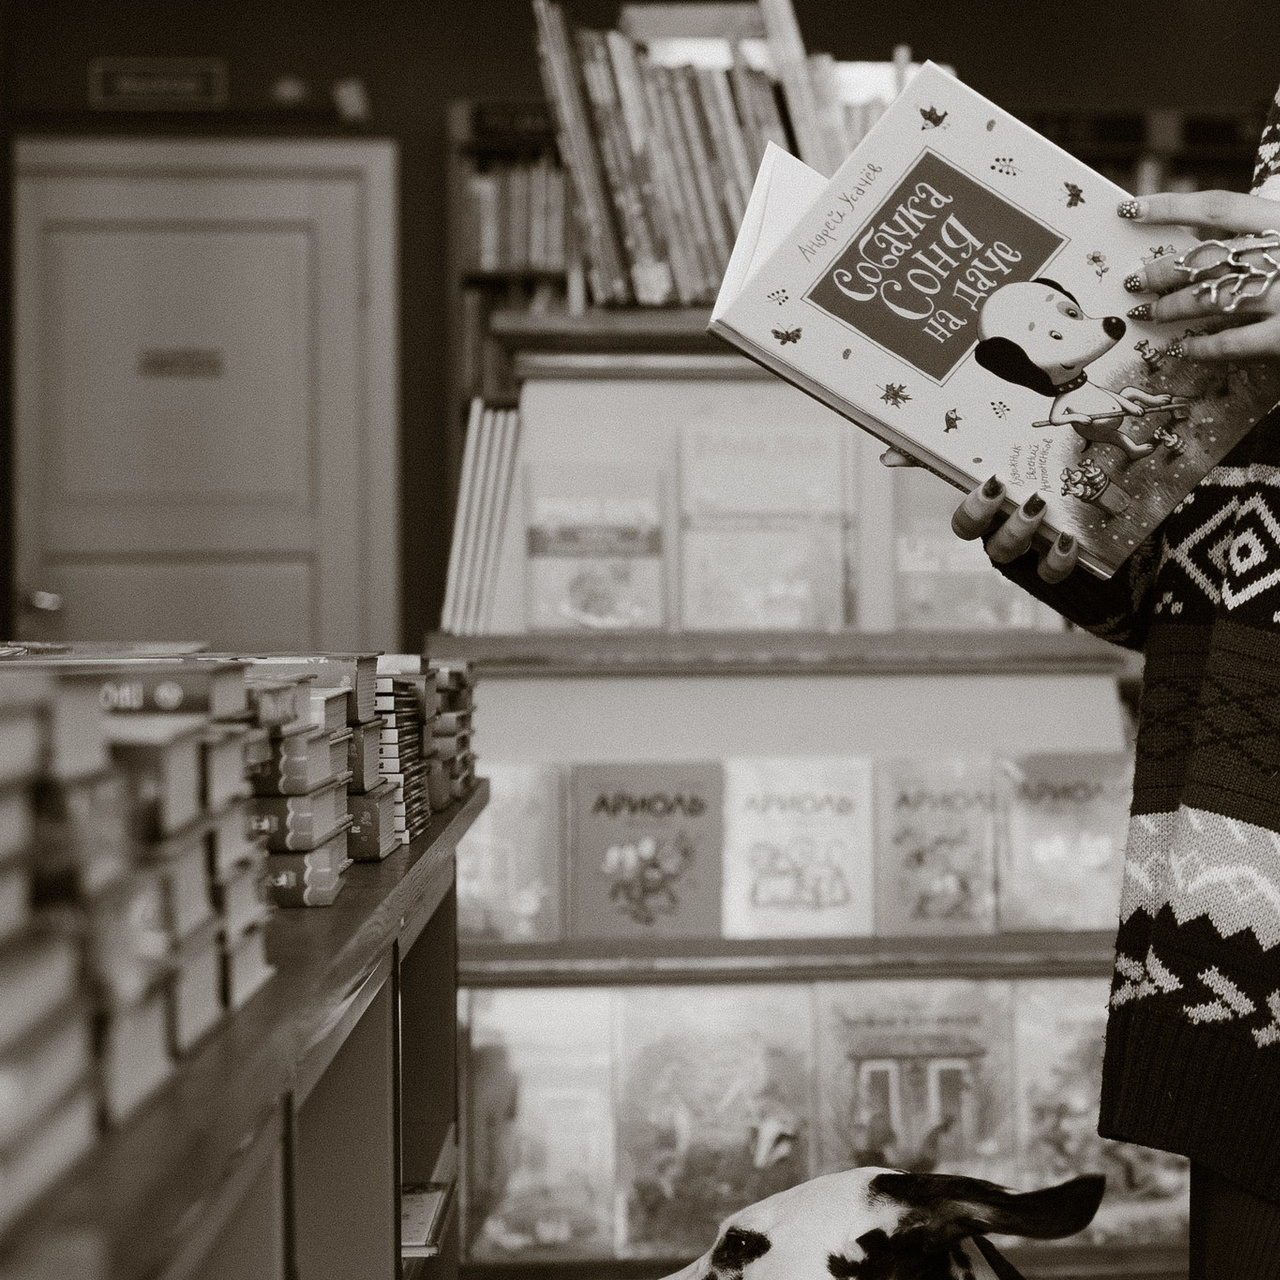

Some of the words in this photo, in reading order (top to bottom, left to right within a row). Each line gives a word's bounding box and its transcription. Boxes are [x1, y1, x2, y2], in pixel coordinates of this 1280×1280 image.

[797, 209, 846, 263] Андрей
[838, 162, 883, 211] Усачёв
[833, 182, 954, 302] Собачка
[880, 213, 984, 320] Соня
[922, 309, 968, 344] на
[952, 241, 1022, 311] даче
